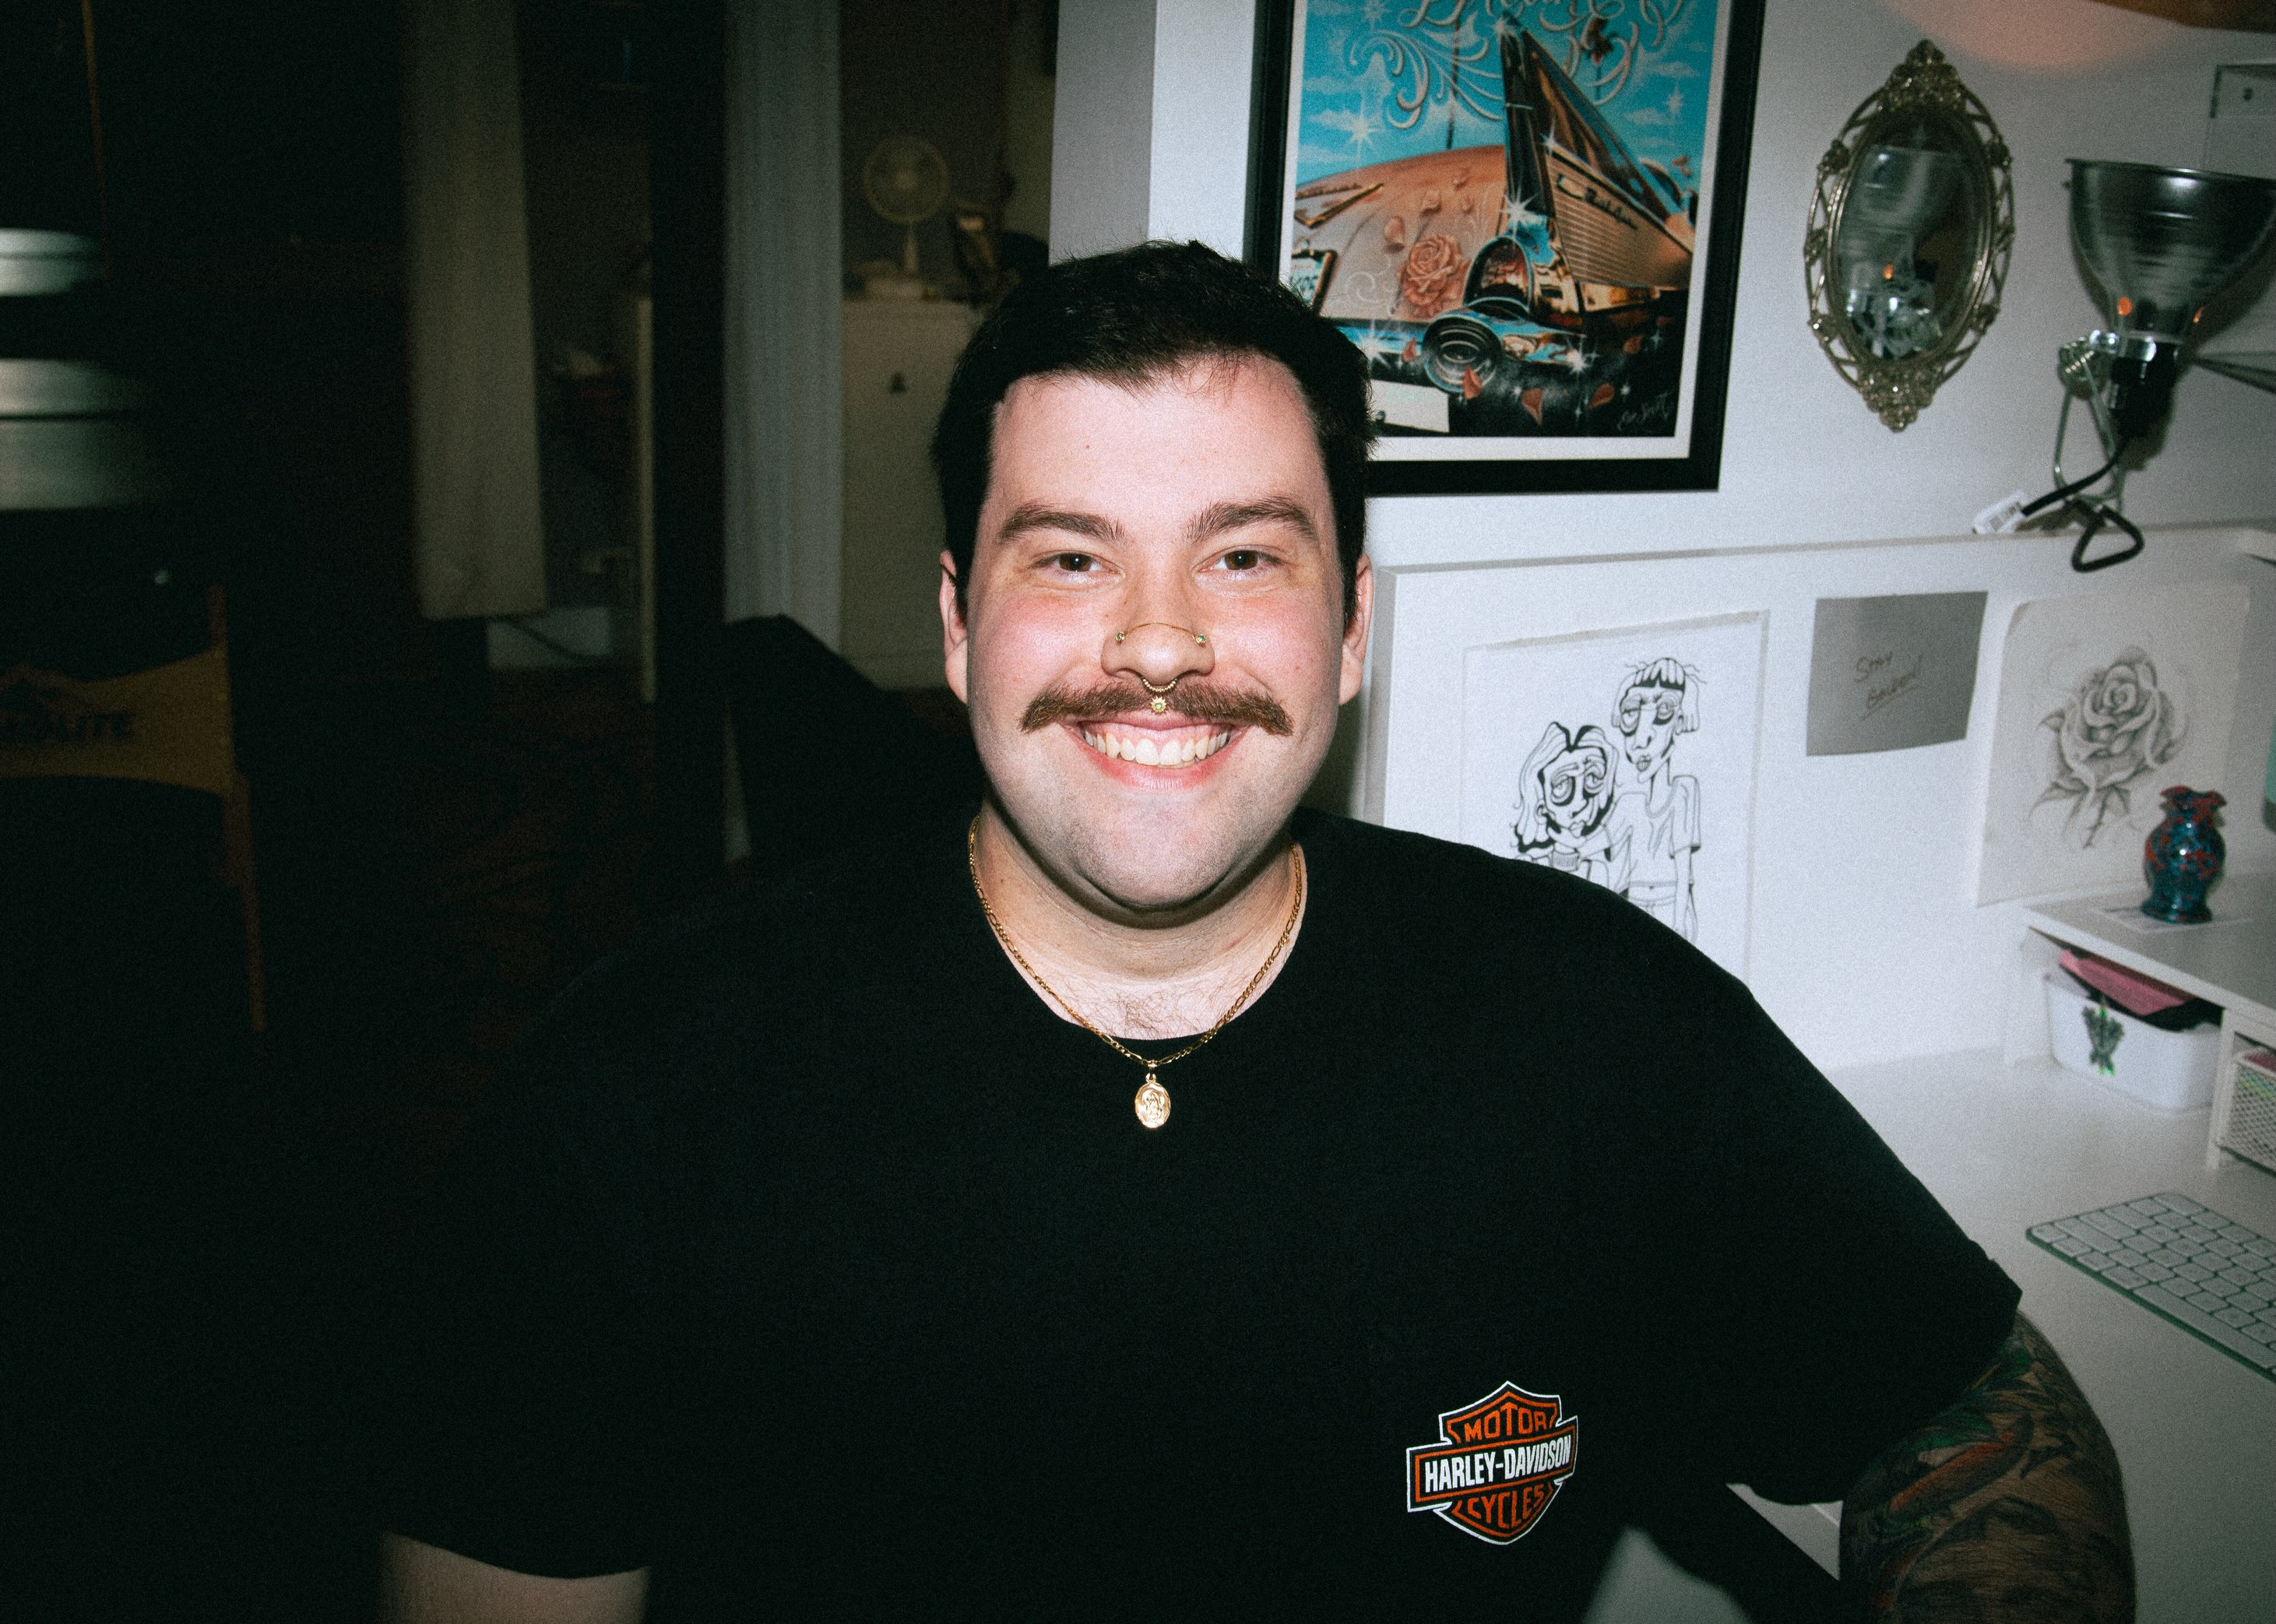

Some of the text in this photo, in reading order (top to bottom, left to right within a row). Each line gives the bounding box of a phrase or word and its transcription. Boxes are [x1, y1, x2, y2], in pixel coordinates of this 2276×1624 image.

[1464, 1401, 1547, 1443] MOTOR
[1424, 1434, 1571, 1493] HARLEY-DAVIDSON
[1467, 1483, 1545, 1529] CYCLES
